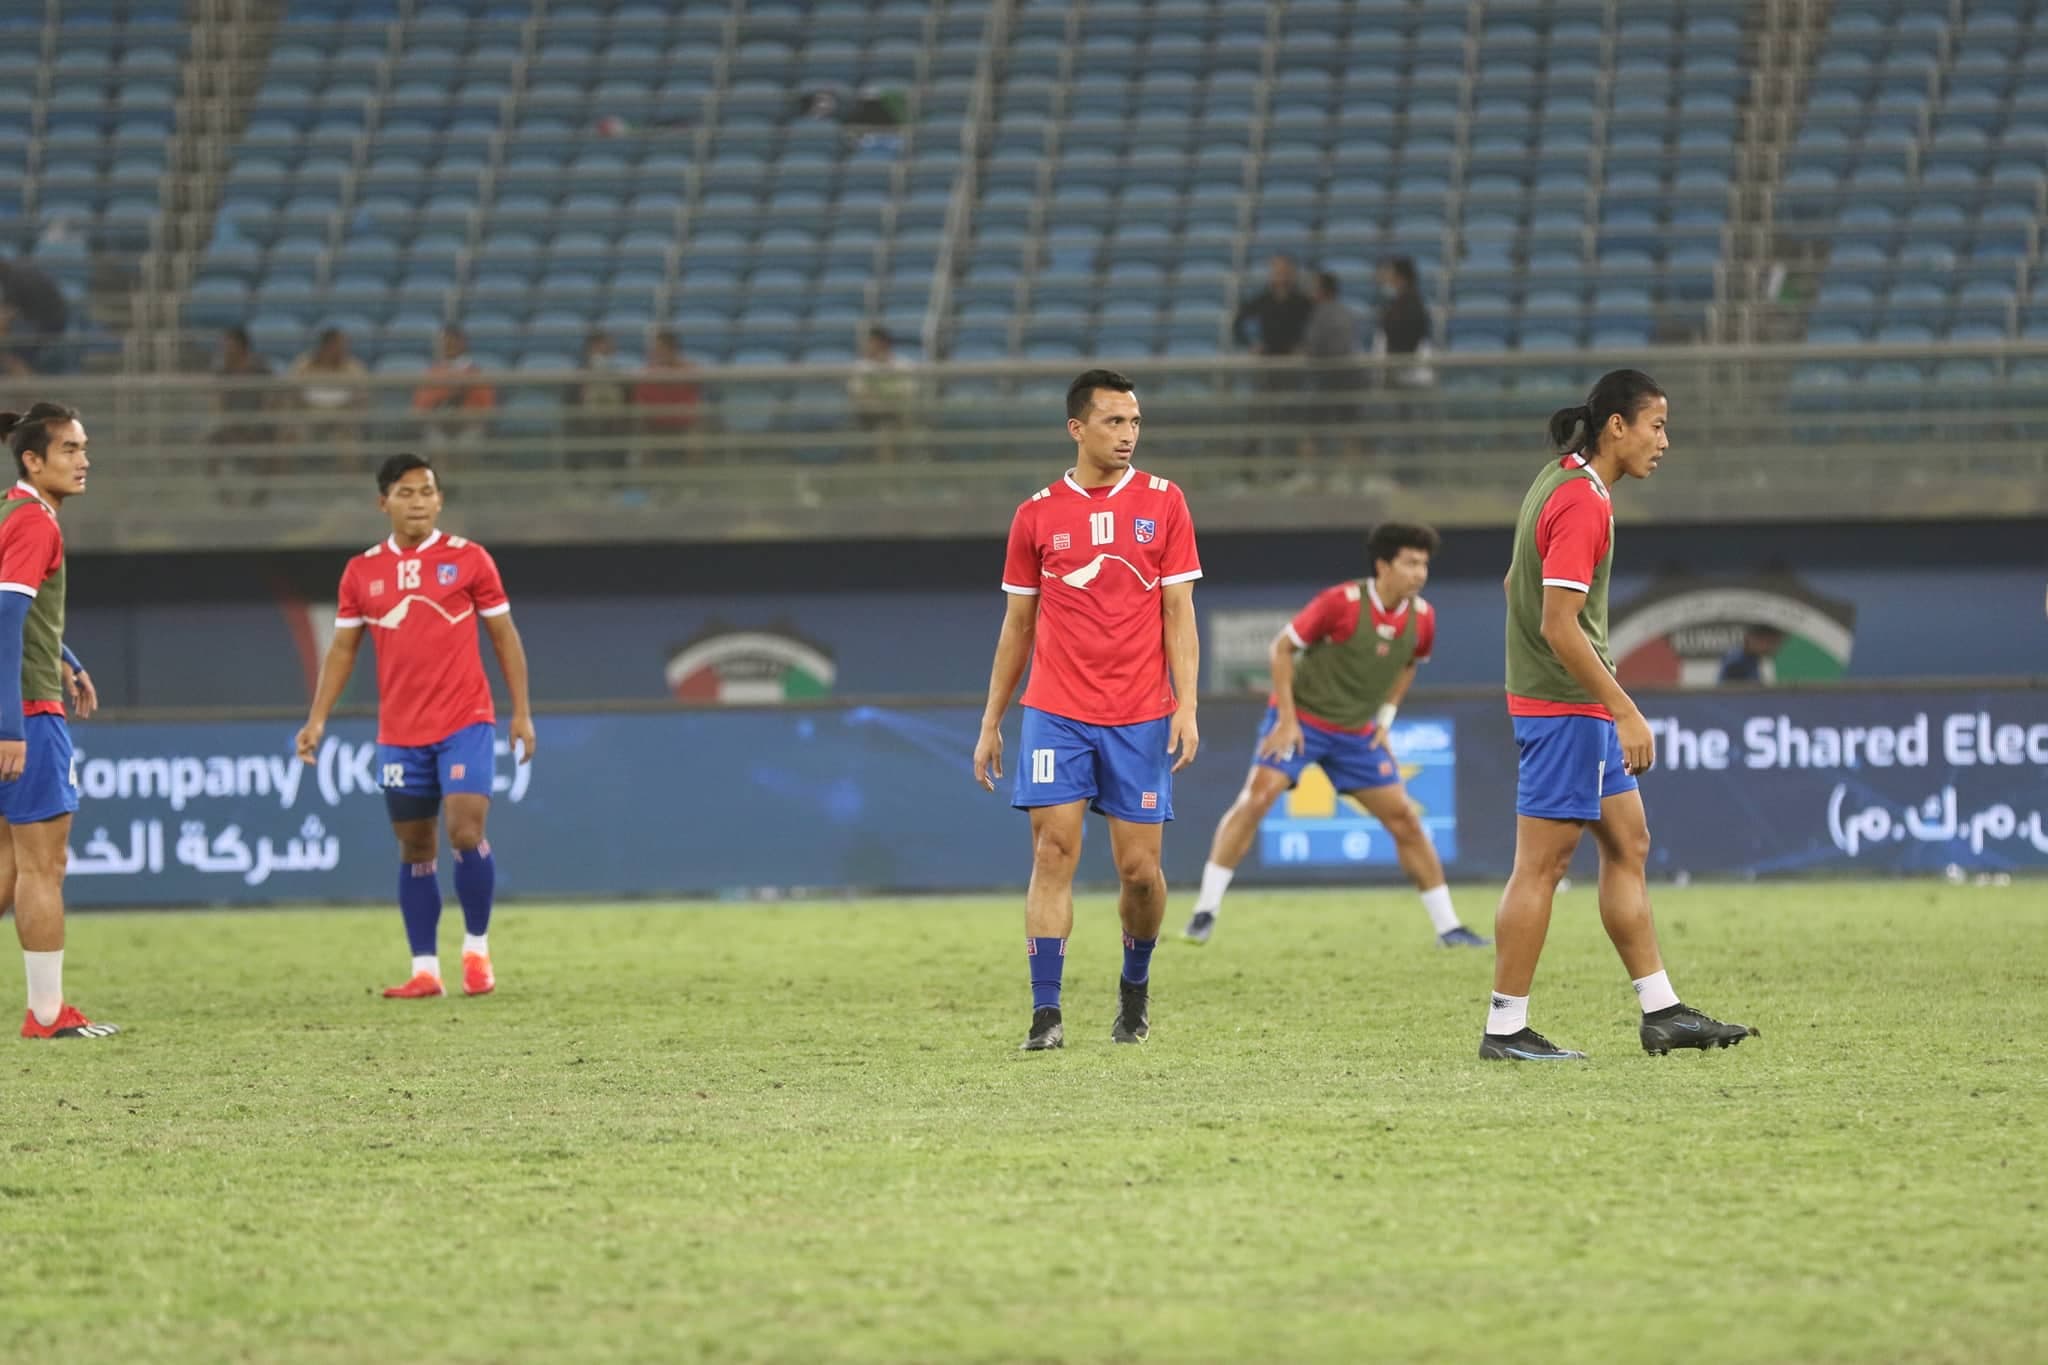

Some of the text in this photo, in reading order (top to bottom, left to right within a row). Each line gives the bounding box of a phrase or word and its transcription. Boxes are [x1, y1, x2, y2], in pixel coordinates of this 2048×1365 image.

[1089, 511, 1114, 546] 10
[397, 559, 422, 590] 13
[1743, 712, 1929, 769] Shared
[1943, 711, 2048, 766] Elec
[74, 748, 304, 811] ompany
[1032, 749, 1055, 783] 10
[176, 814, 339, 884] شركة
